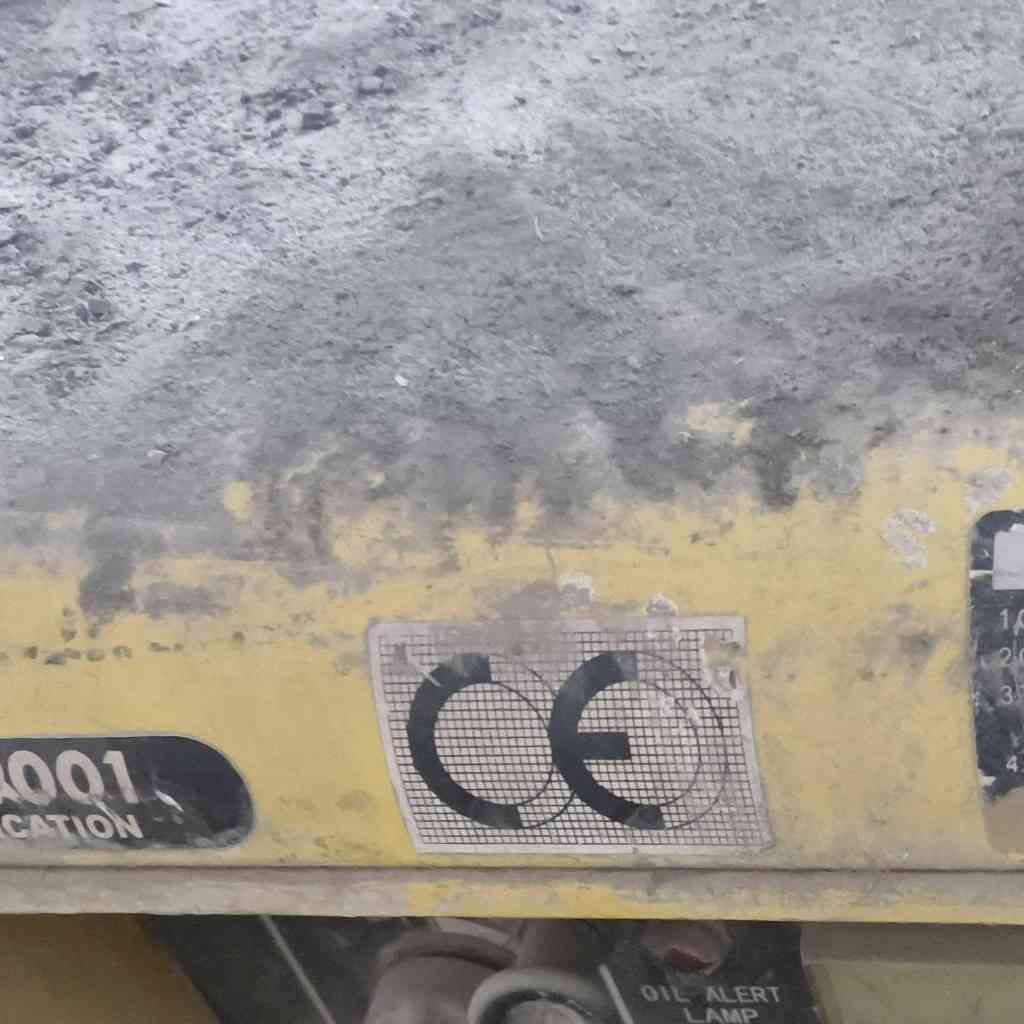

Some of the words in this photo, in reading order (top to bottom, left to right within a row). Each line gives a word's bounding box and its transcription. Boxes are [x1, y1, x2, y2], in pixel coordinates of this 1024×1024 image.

[0, 750, 139, 805] 001
[0, 814, 143, 839] CATION
[640, 984, 690, 1003] OIL
[706, 986, 781, 1003] ALERT
[683, 1008, 758, 1024] LAMP
